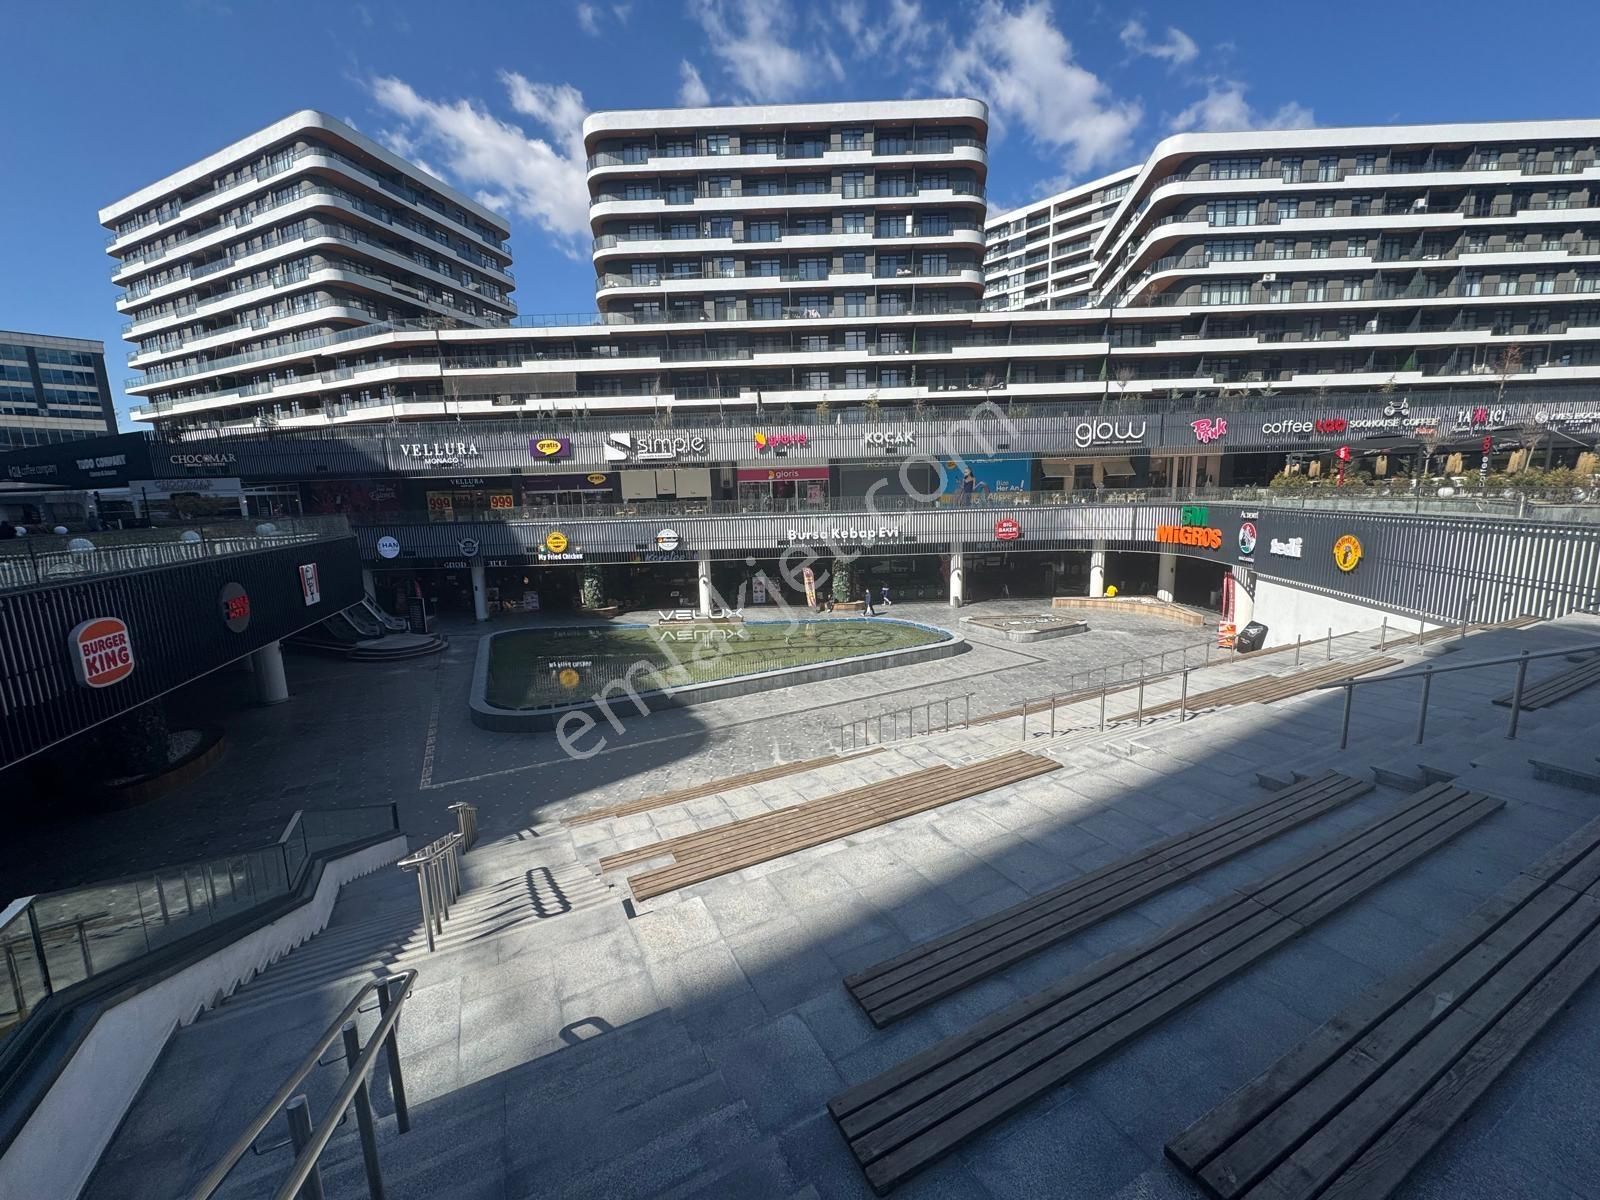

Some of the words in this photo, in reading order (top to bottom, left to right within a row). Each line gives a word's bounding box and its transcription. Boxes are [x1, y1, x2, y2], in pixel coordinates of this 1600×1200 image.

[1262, 419, 1313, 434] coffee
[1075, 420, 1146, 448] glow
[400, 443, 479, 456] VELLURA
[538, 442, 559, 450] gratis
[637, 433, 704, 458] simple
[95, 454, 126, 468] COANY
[775, 470, 799, 479] gloris
[430, 497, 450, 509] 999
[491, 496, 512, 507] 999
[789, 529, 827, 540] Bursa
[831, 528, 875, 540] Kebap
[878, 527, 898, 537] Evi
[658, 610, 744, 620] VELUX
[82, 633, 127, 657] BURGER
[85, 646, 130, 677] KING
